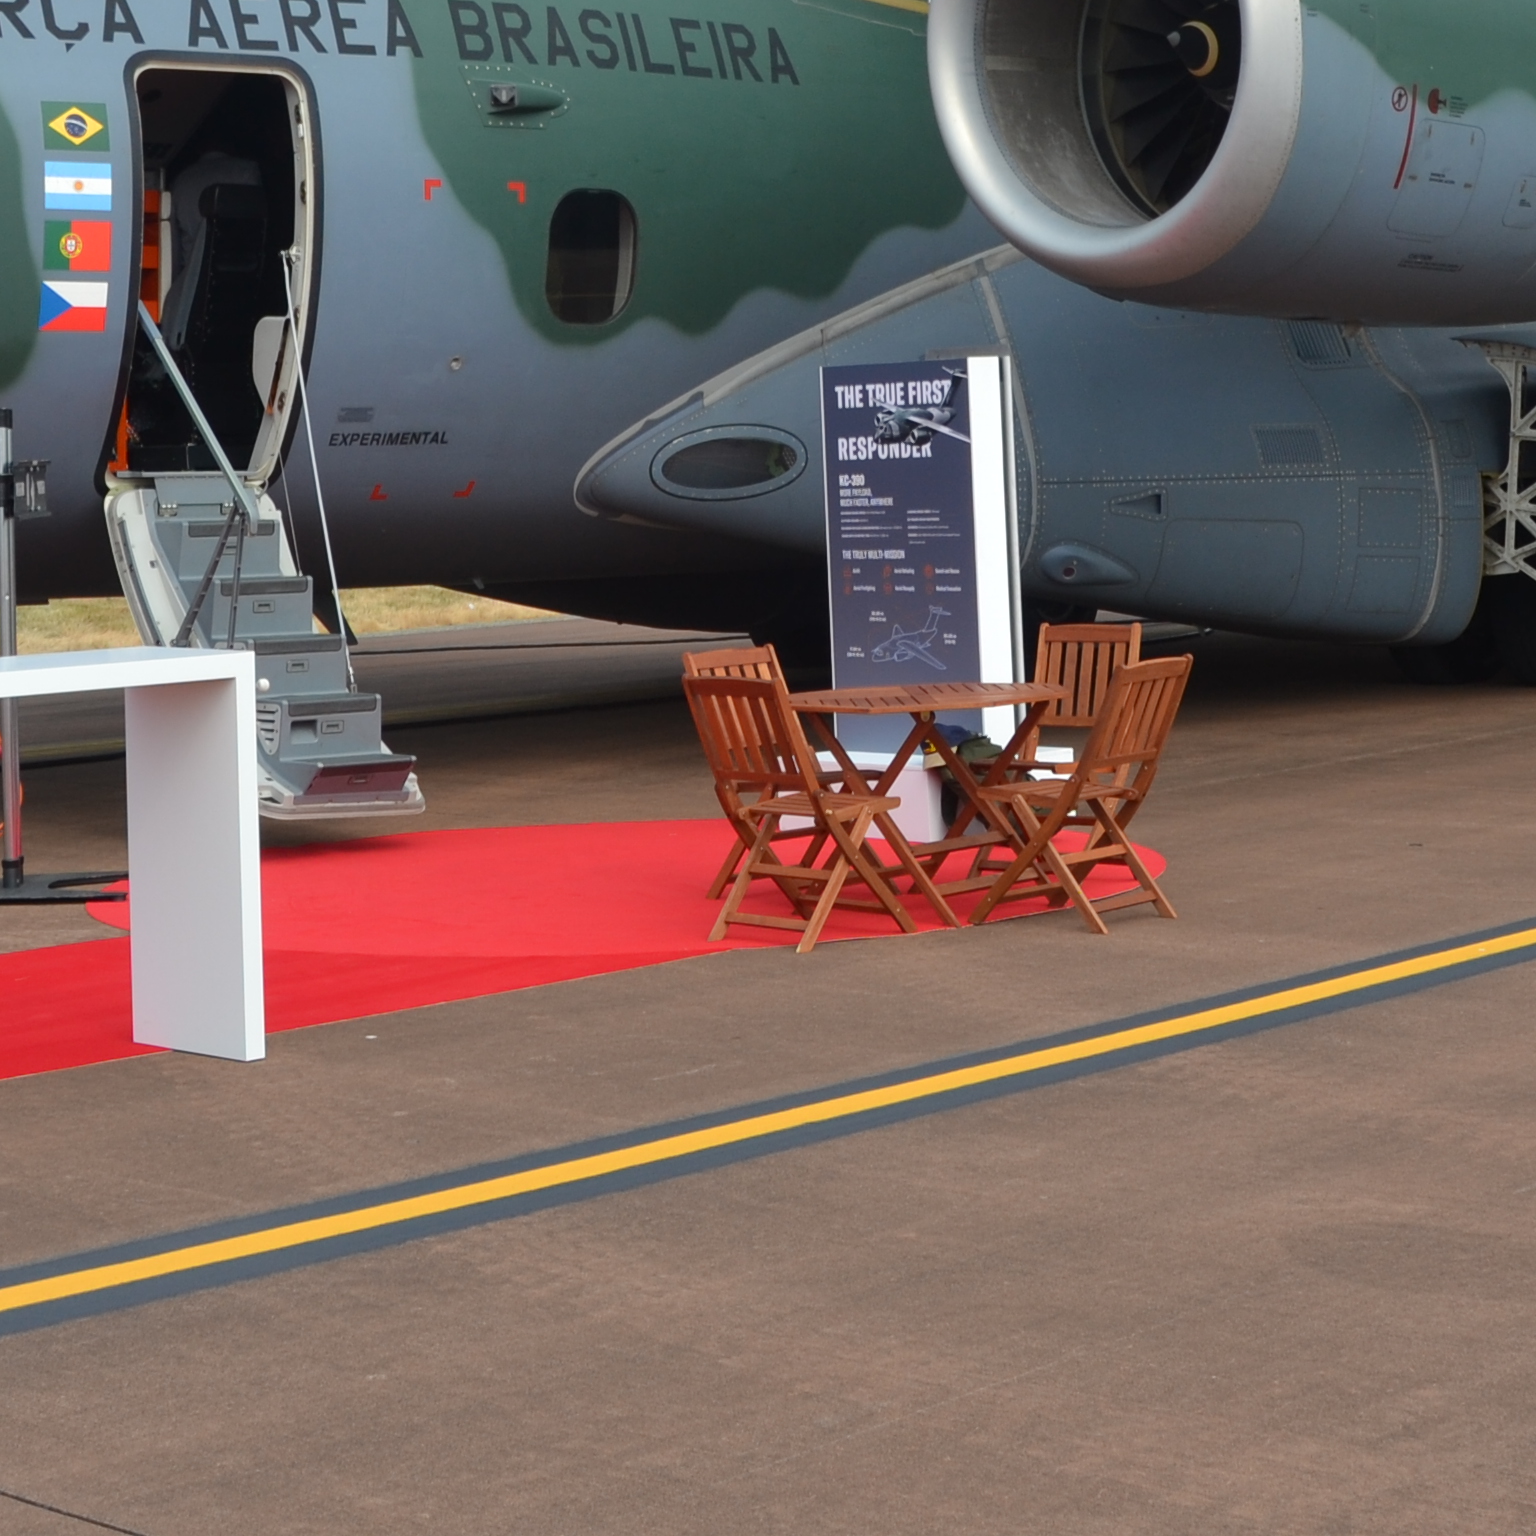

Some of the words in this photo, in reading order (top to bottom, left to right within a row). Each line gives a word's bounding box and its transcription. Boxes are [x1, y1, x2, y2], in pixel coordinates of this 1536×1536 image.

[448, 0, 800, 86] BRASILEIRA
[835, 385, 864, 409] THE
[866, 382, 905, 407] TRUE
[908, 379, 951, 405] FIRST
[328, 431, 448, 447] EXPERIMENTAL
[838, 436, 932, 461] RESPONDER
